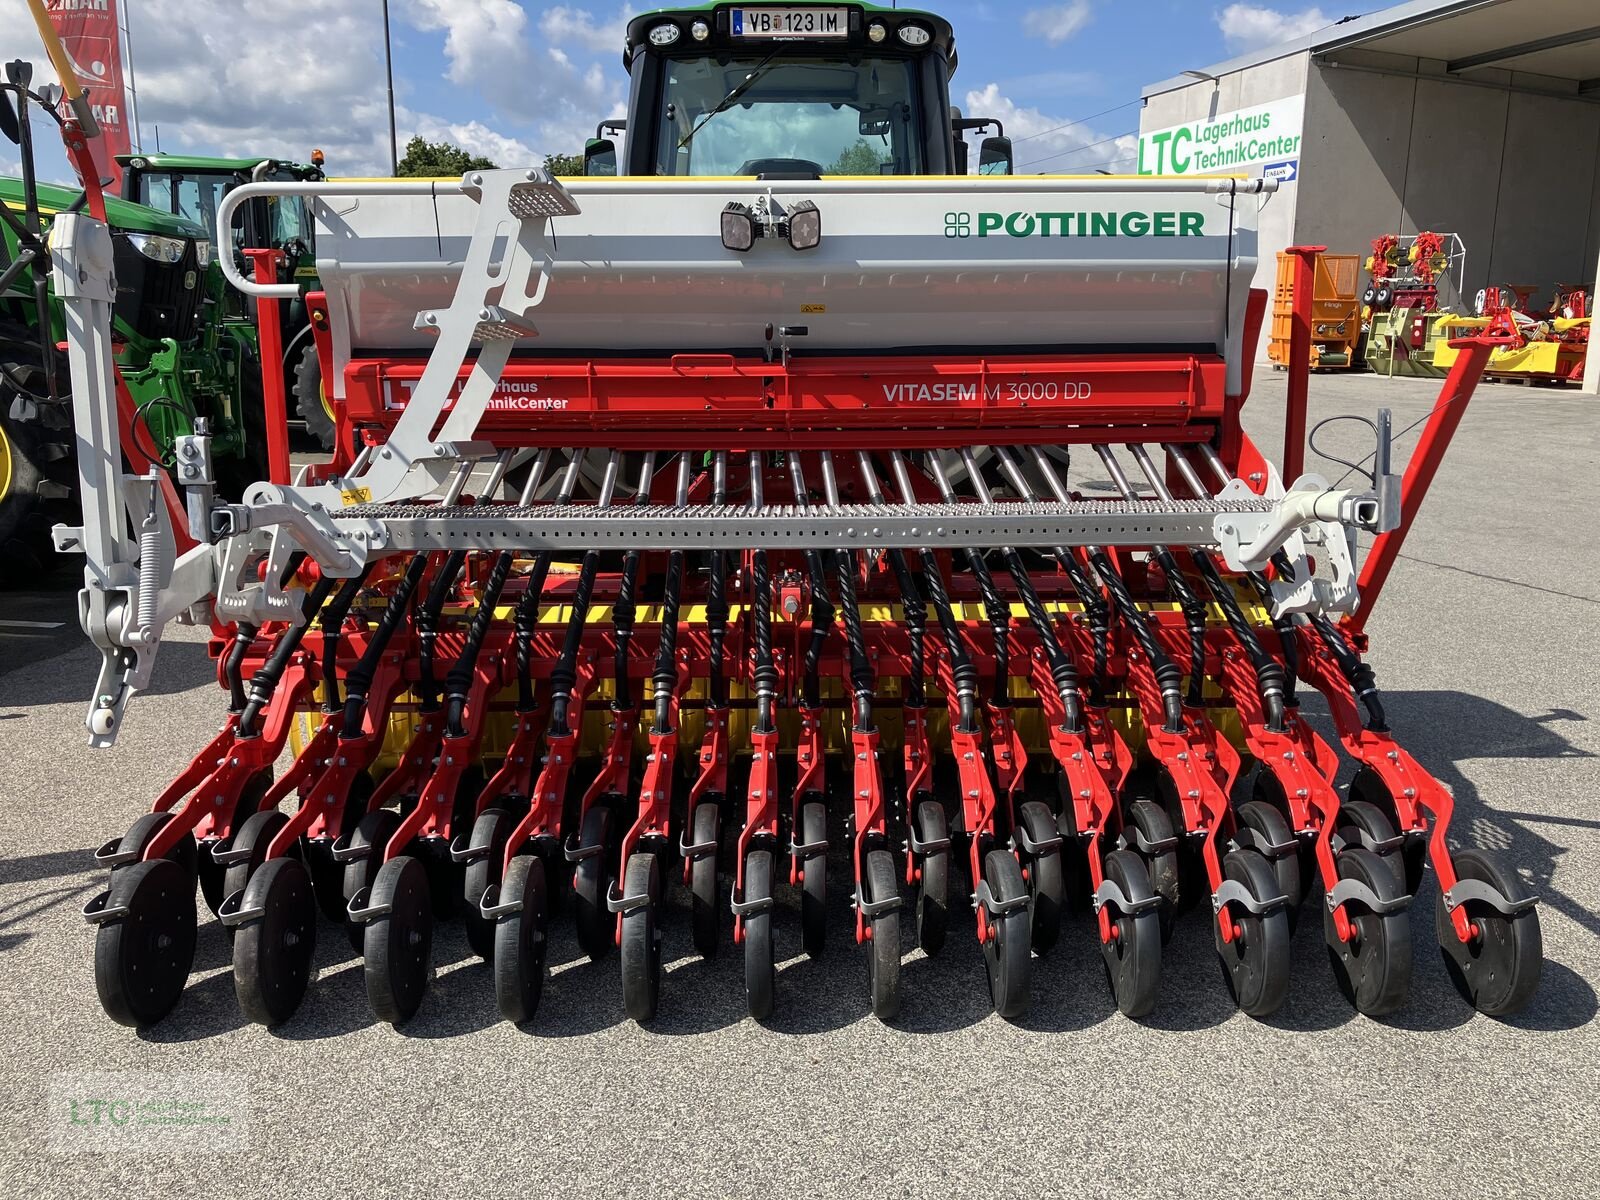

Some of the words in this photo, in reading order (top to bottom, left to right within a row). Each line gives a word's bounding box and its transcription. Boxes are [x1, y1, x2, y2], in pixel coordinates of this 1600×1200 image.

[750, 13, 771, 32] VB
[785, 13, 814, 32] 123
[820, 13, 838, 32] IM
[1195, 112, 1270, 144] Lagerhaus
[1138, 127, 1192, 175] LTC
[1194, 135, 1300, 170] TechnikCenter
[978, 211, 1205, 238] PÖTTINGER
[458, 380, 538, 393] Lrhaus
[883, 383, 976, 401] VITASEM
[984, 383, 1000, 400] M
[1006, 382, 1058, 400] 3000
[1064, 382, 1092, 400] DD
